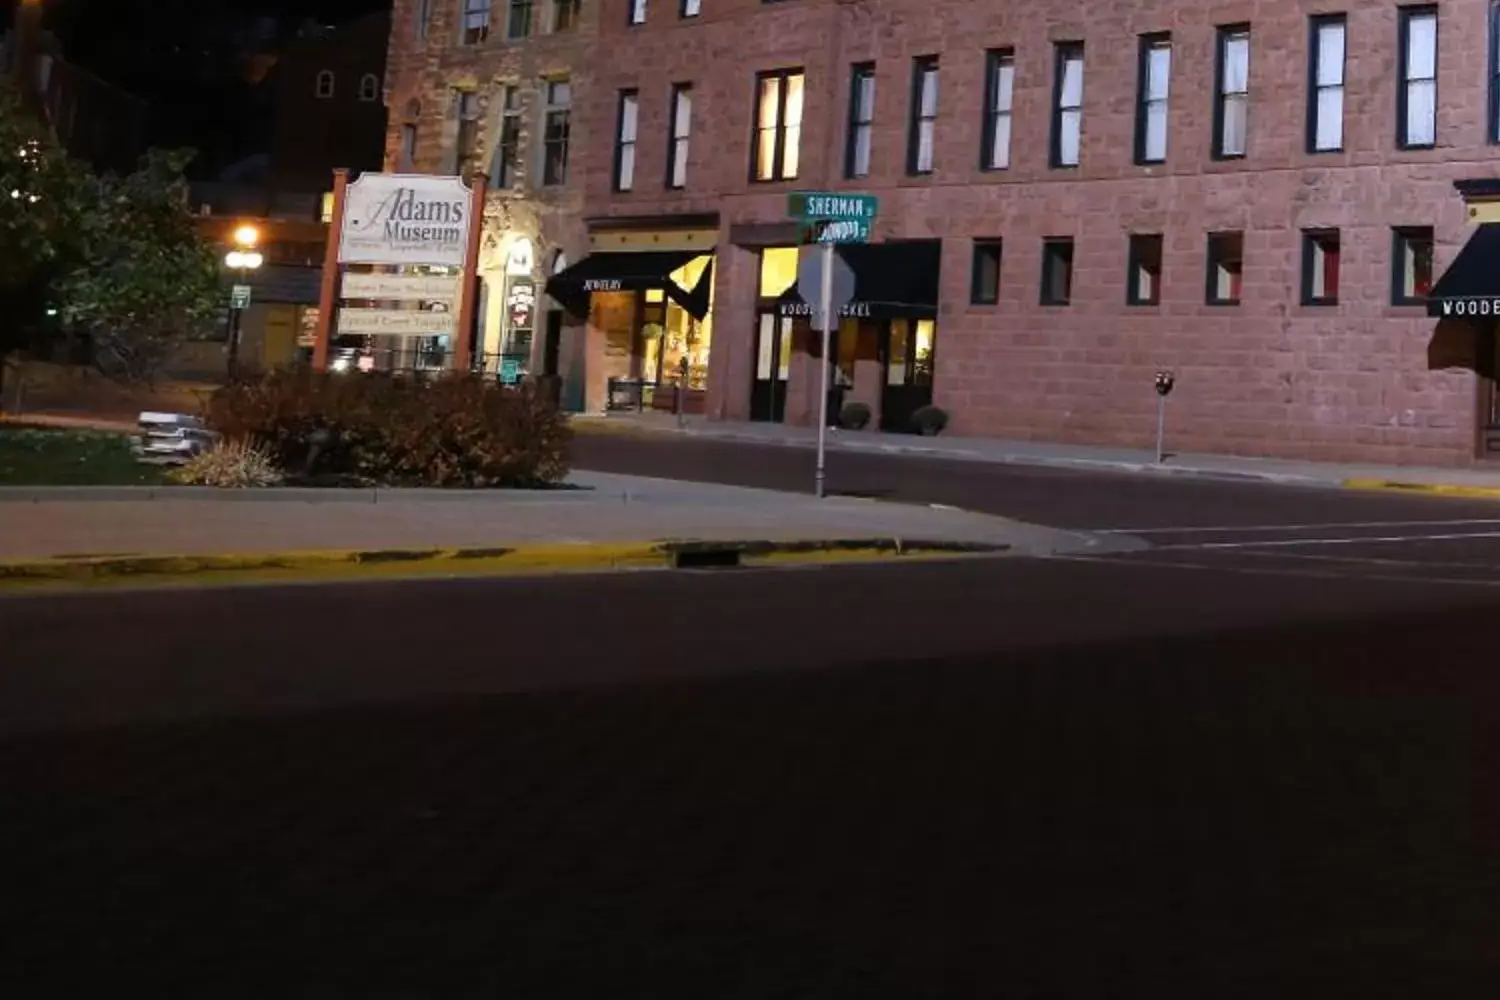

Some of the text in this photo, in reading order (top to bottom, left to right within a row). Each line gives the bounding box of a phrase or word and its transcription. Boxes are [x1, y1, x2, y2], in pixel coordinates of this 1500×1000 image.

[361, 187, 464, 231] Adams
[807, 196, 864, 216] SHERMAN
[384, 221, 461, 245] Museum
[781, 303, 813, 315] WOOD
